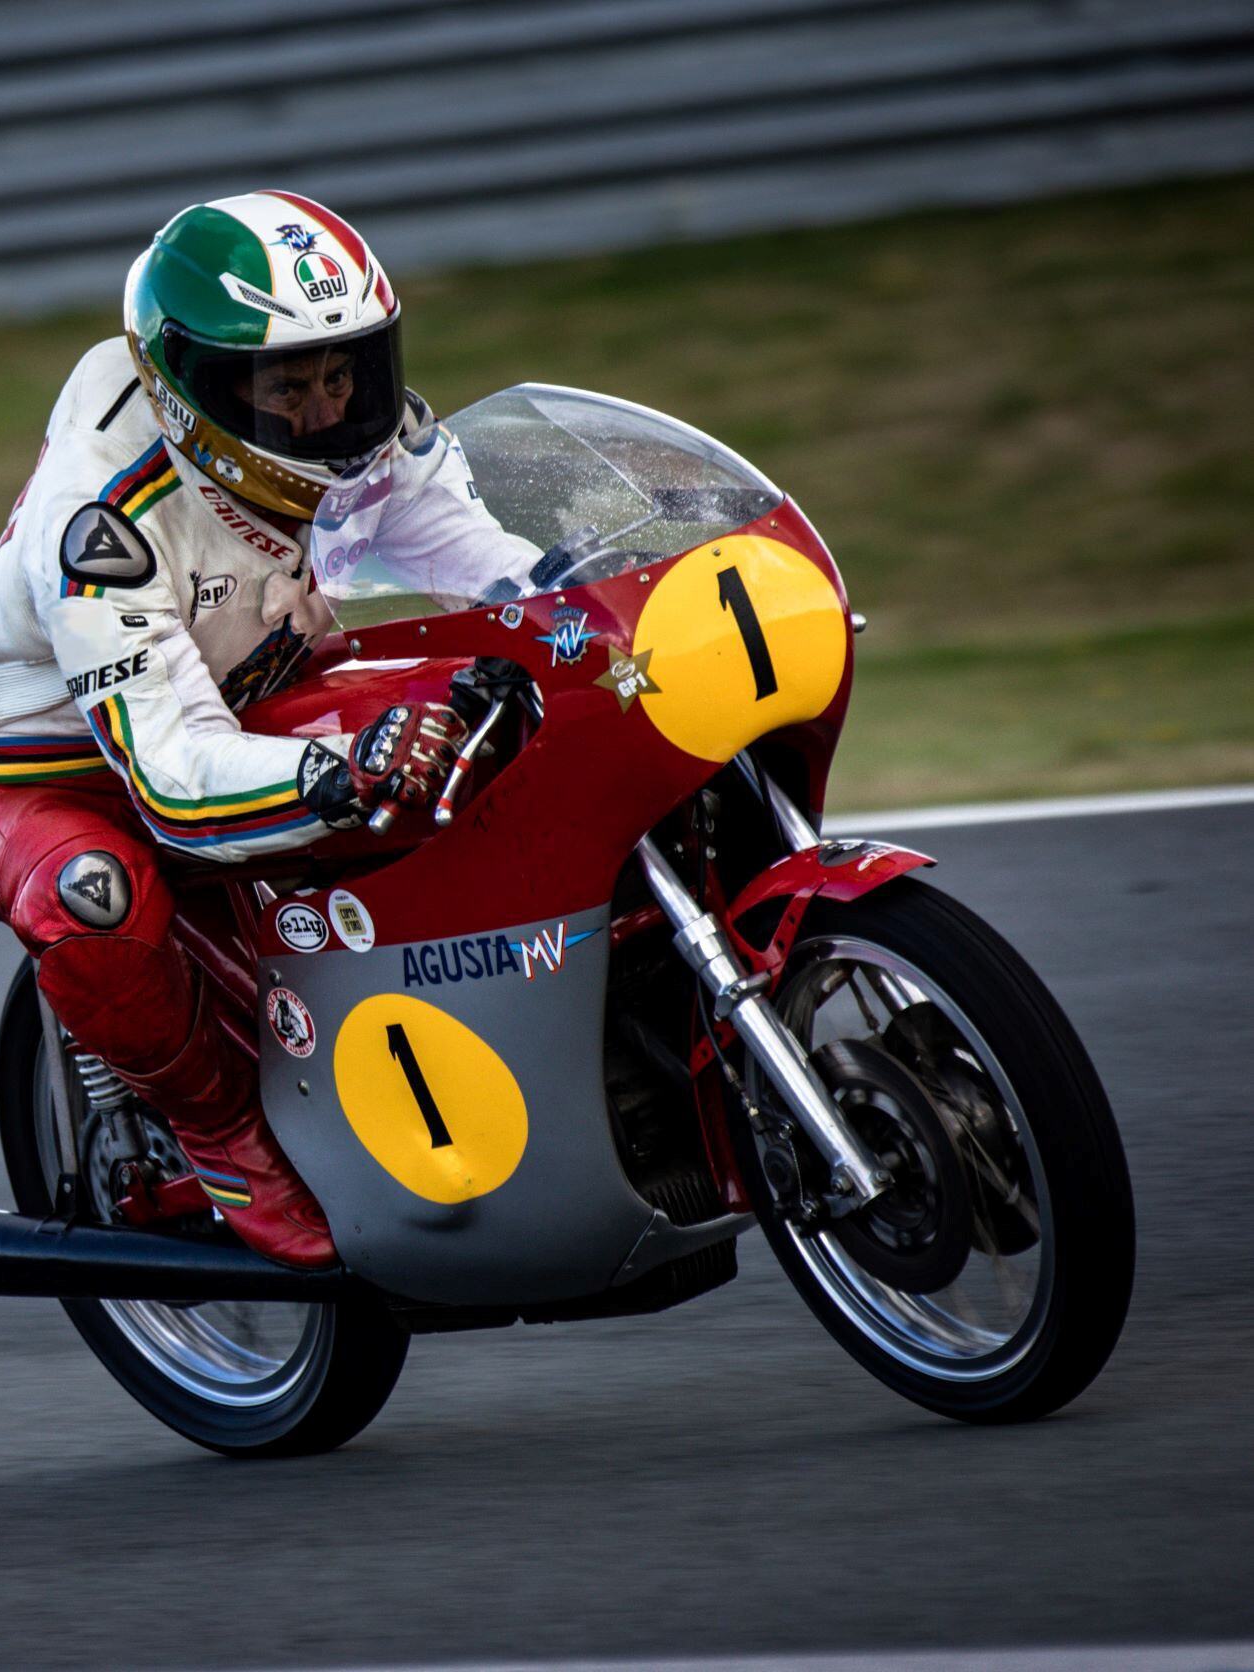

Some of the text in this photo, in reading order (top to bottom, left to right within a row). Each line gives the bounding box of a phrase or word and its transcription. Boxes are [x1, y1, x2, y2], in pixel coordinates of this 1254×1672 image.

[308, 277, 343, 299] agv
[158, 385, 192, 426] agv
[552, 612, 588, 667] MV
[717, 565, 778, 701] 1
[403, 920, 567, 987] AGUSTA MV
[386, 1023, 454, 1149] 1
